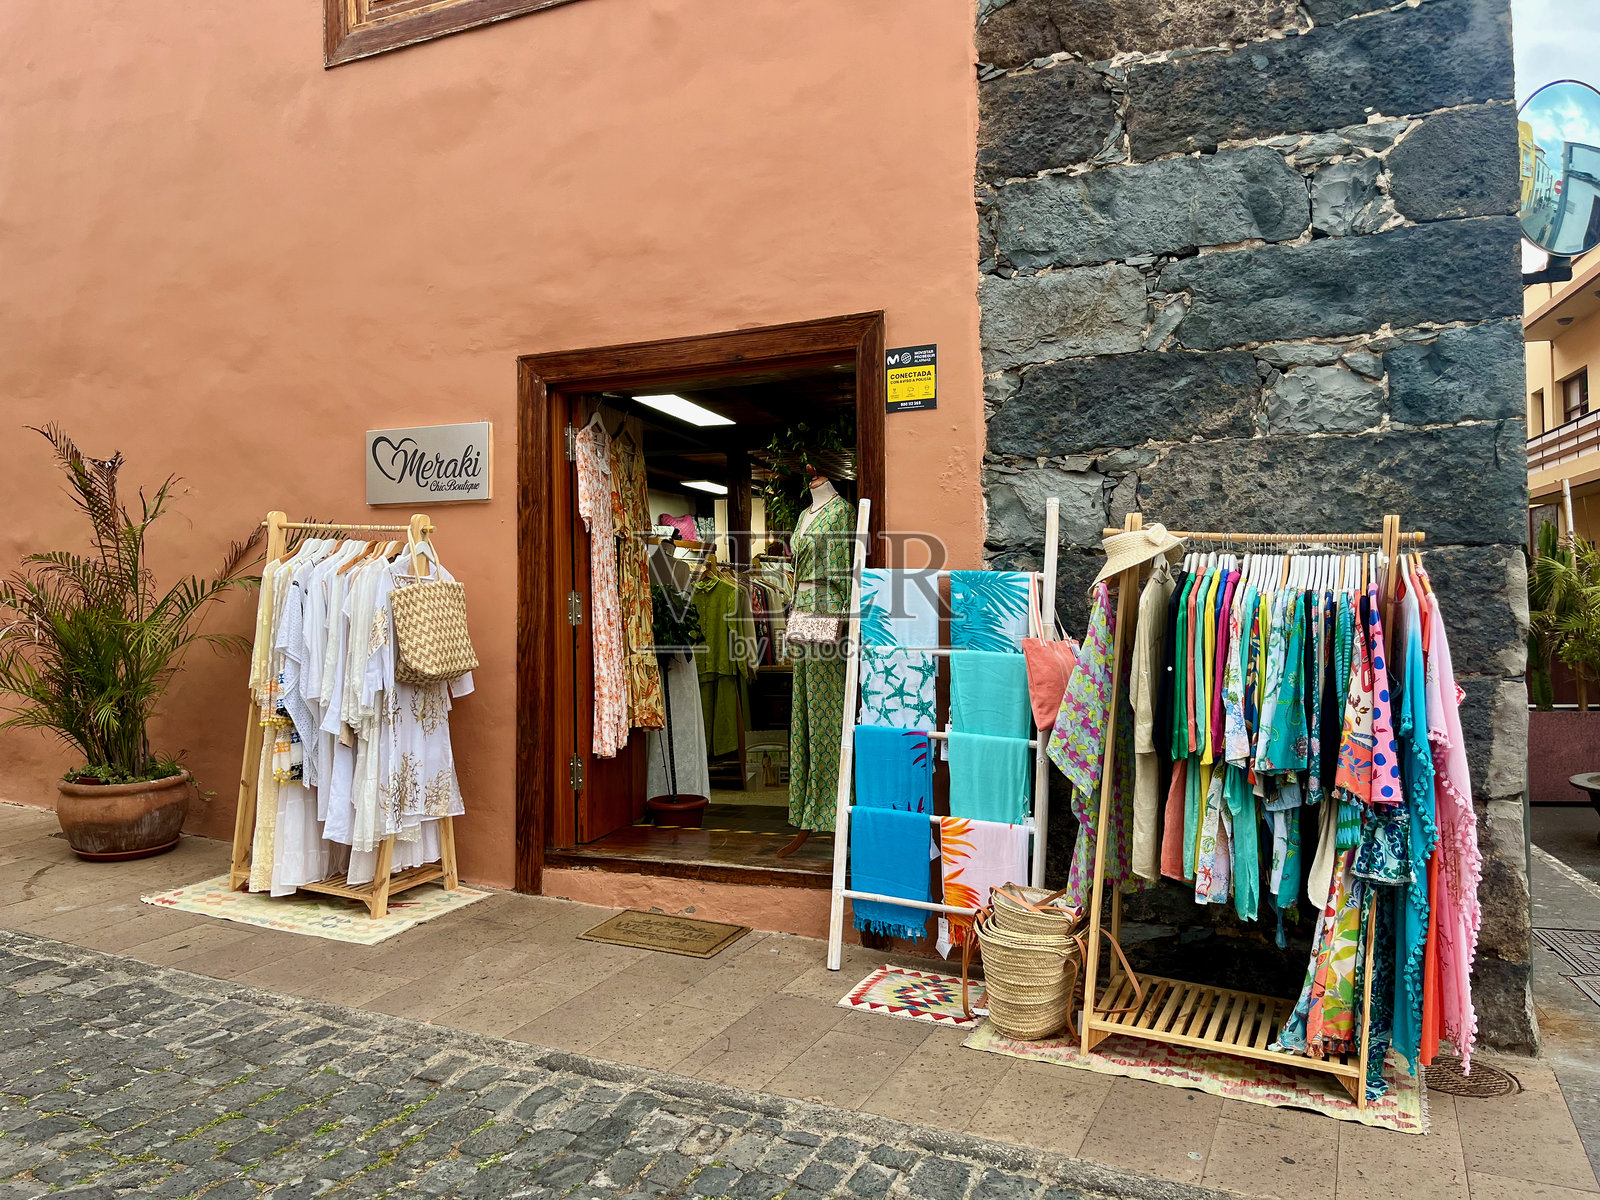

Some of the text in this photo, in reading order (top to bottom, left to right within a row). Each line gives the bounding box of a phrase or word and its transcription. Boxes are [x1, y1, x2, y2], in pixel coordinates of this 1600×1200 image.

[890, 370, 932, 380] CONECTADA
[392, 444, 482, 488] Meraki
[429, 478, 480, 493] Chic Boutique
[615, 921, 717, 942] WELCOME
